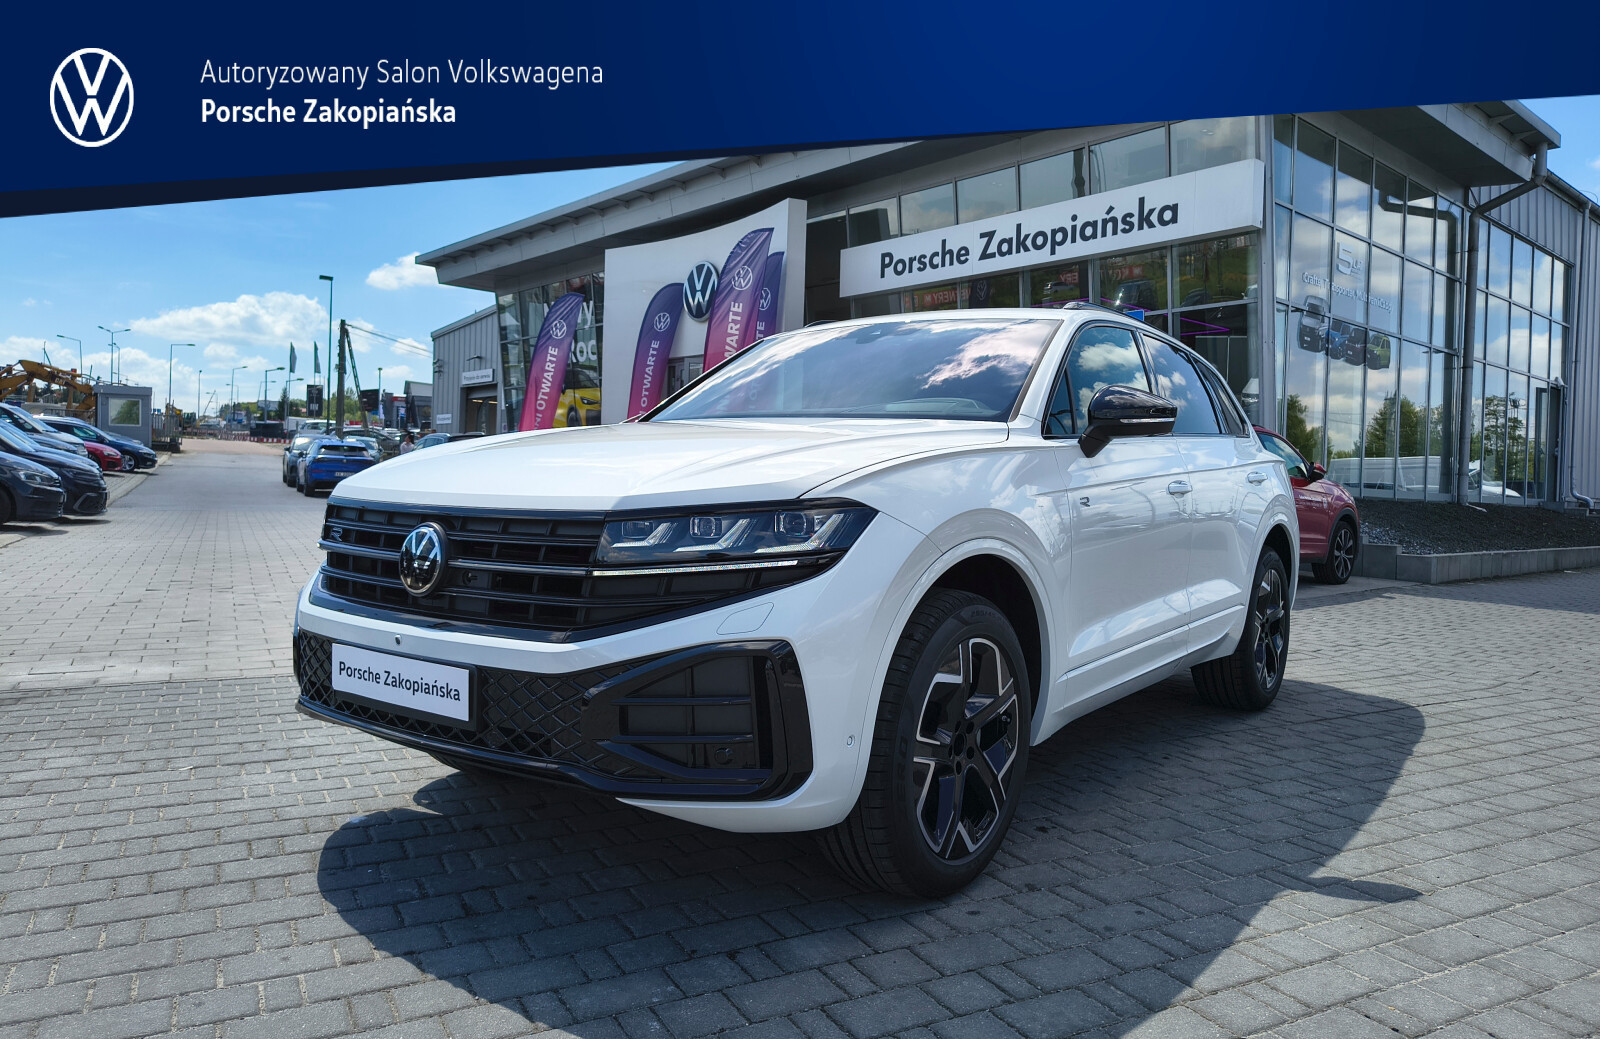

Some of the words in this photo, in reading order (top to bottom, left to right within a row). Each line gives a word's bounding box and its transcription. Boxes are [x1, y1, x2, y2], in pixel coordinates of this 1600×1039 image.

[880, 238, 970, 279] Porsche
[978, 196, 1179, 262] Zakopiańska
[536, 345, 559, 411] OTWARTE
[640, 340, 660, 408] OTWARTE
[338, 660, 381, 685] Porsche
[383, 670, 461, 702] Zakopiańska
